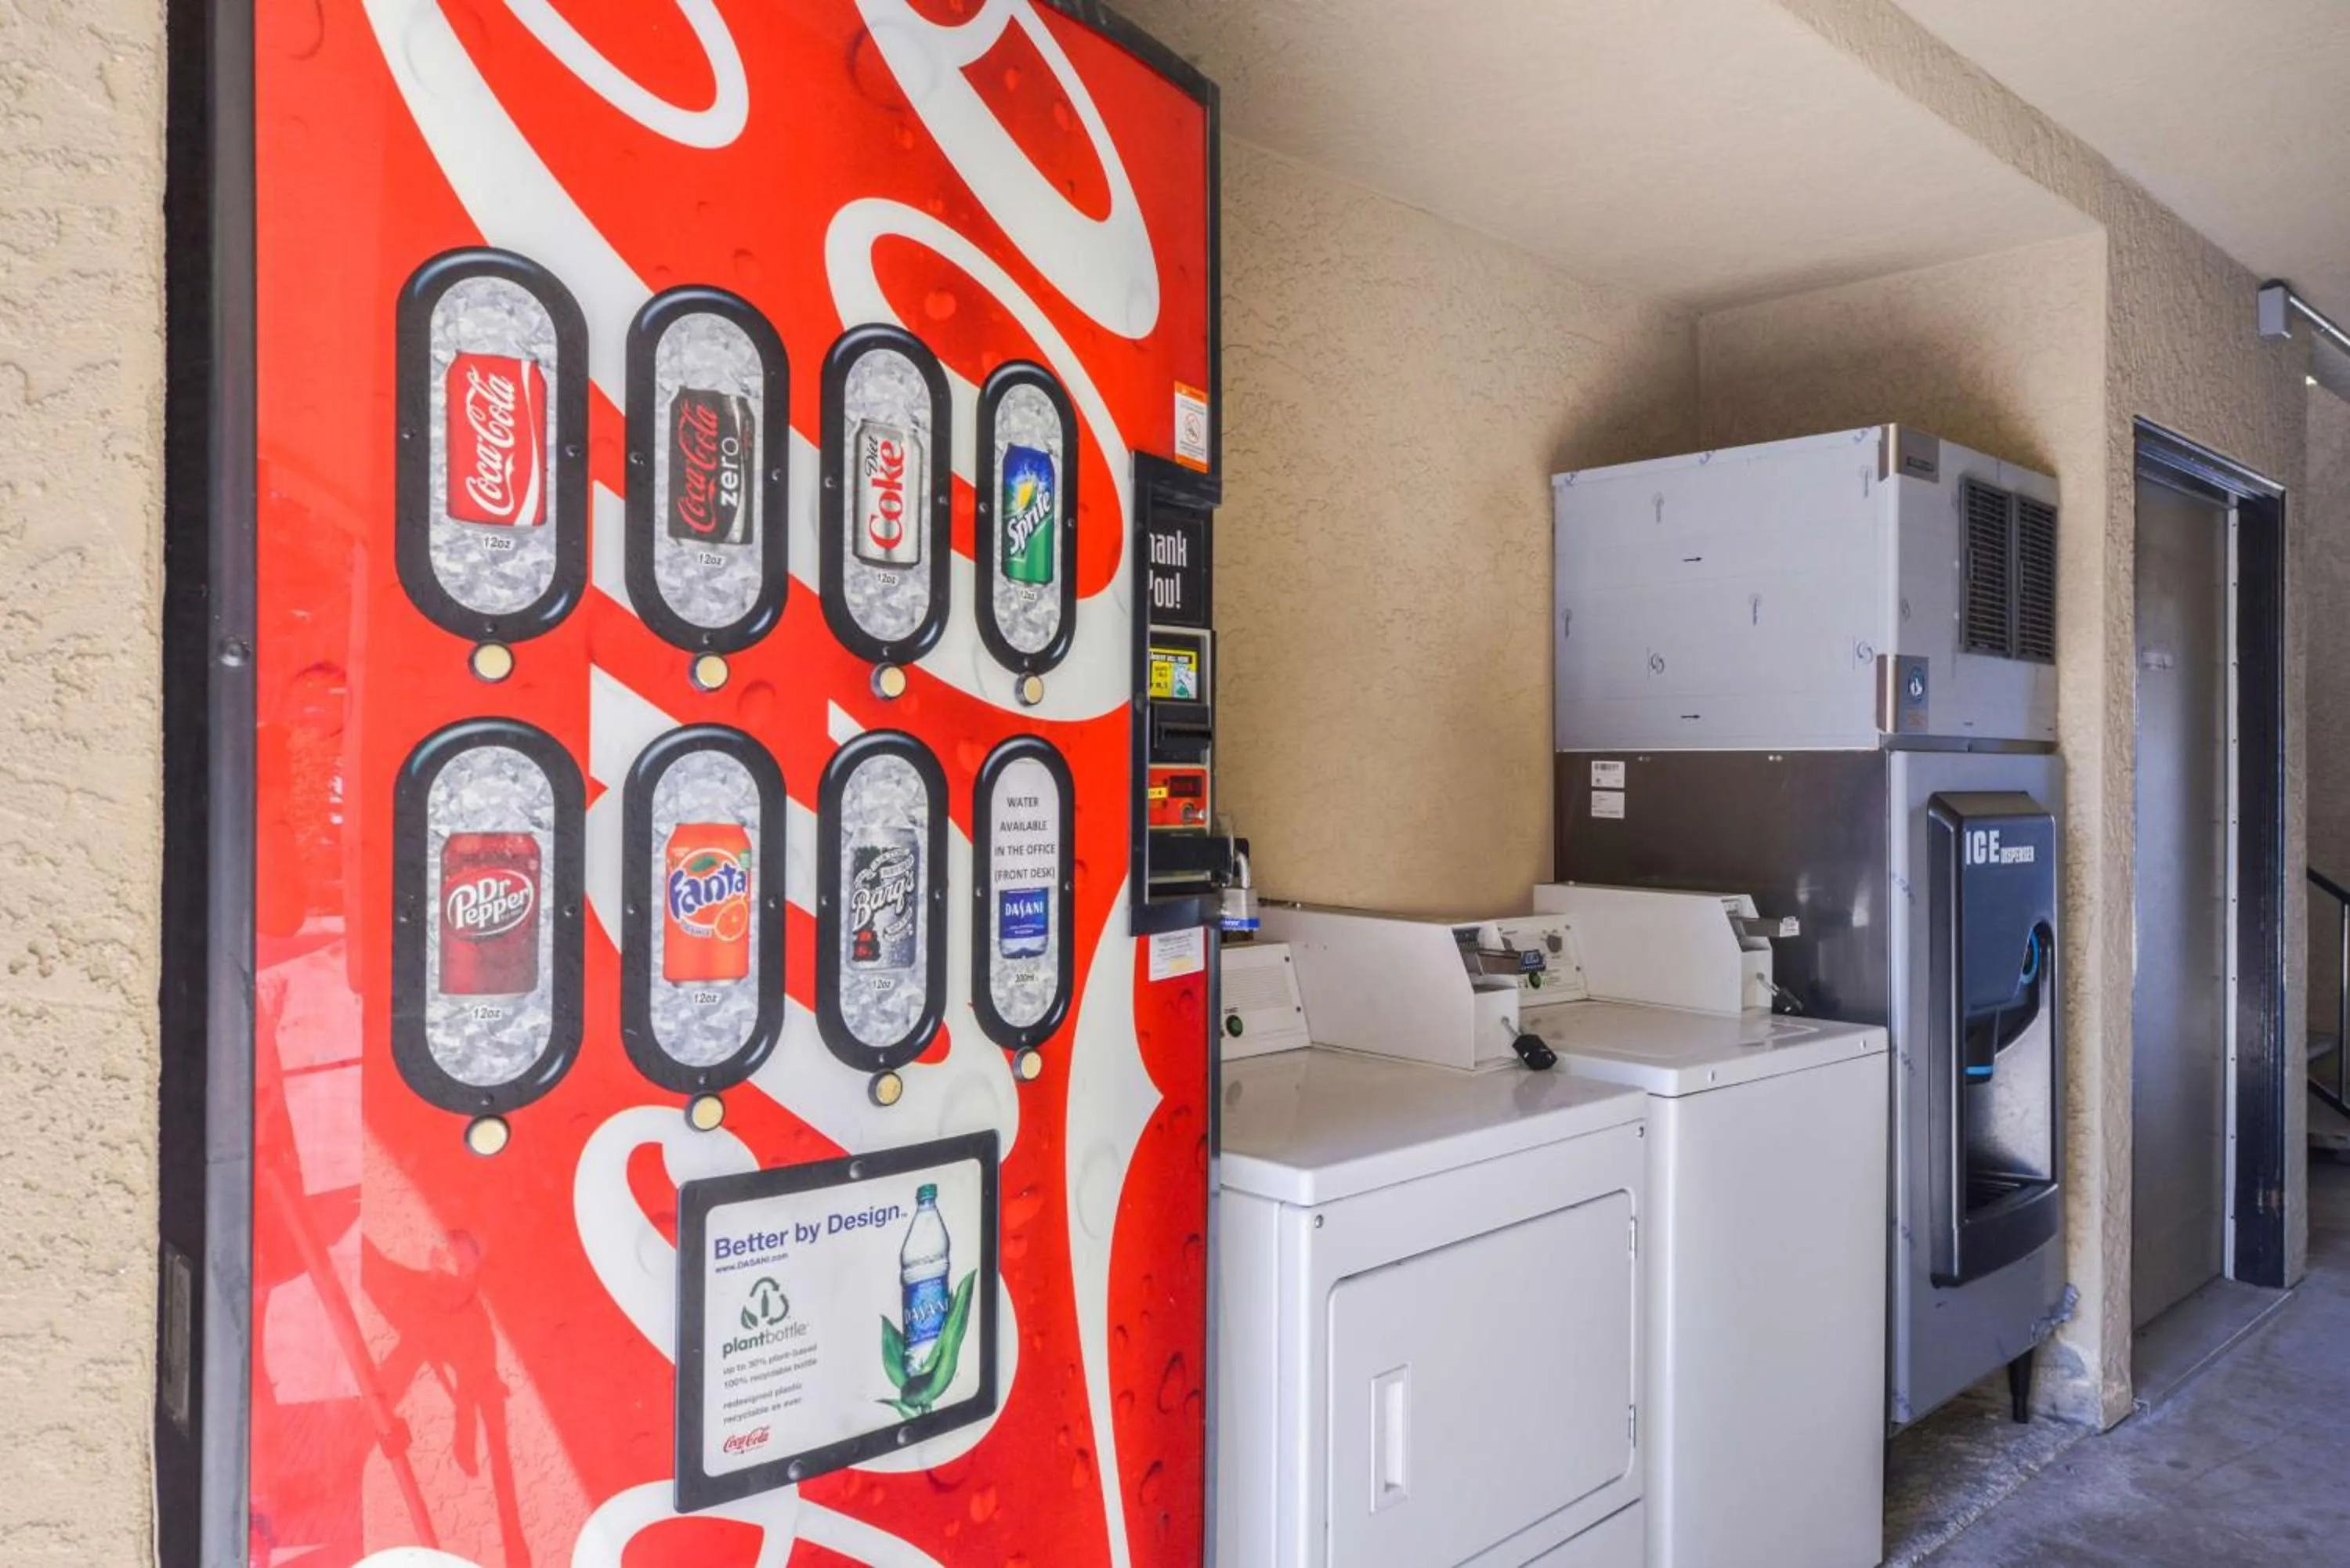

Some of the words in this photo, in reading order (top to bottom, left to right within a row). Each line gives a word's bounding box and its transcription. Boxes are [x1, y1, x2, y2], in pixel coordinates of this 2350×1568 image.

[465, 363, 515, 516] Coca-Cola
[864, 436, 879, 477] Diet
[721, 437, 739, 508] zero
[870, 440, 905, 550] Coke
[1007, 490, 1051, 555] Sprite
[483, 537, 512, 548] 12oz
[699, 554, 723, 565] 12oz
[1007, 797, 1039, 807] WATER
[1000, 820, 1048, 831] AVAILABLE
[994, 846, 1004, 856] IN
[1007, 845, 1024, 855] THE
[1027, 844, 1056, 854] OFFICE
[1965, 830, 2000, 865] ICE
[477, 878, 511, 904] Dr
[852, 870, 914, 934] Barq's
[456, 884, 530, 929] Pepper
[1005, 899, 1044, 918] DASANI
[694, 993, 718, 1004] 12oz
[473, 1008, 501, 1019] 12oz
[714, 1230, 789, 1259] Better
[795, 1223, 822, 1244] by
[715, 1253, 789, 1274] www.DASANI.com
[725, 1378, 748, 1389] 100%
[750, 1366, 792, 1383] recyclable
[794, 1358, 818, 1371] bottle
